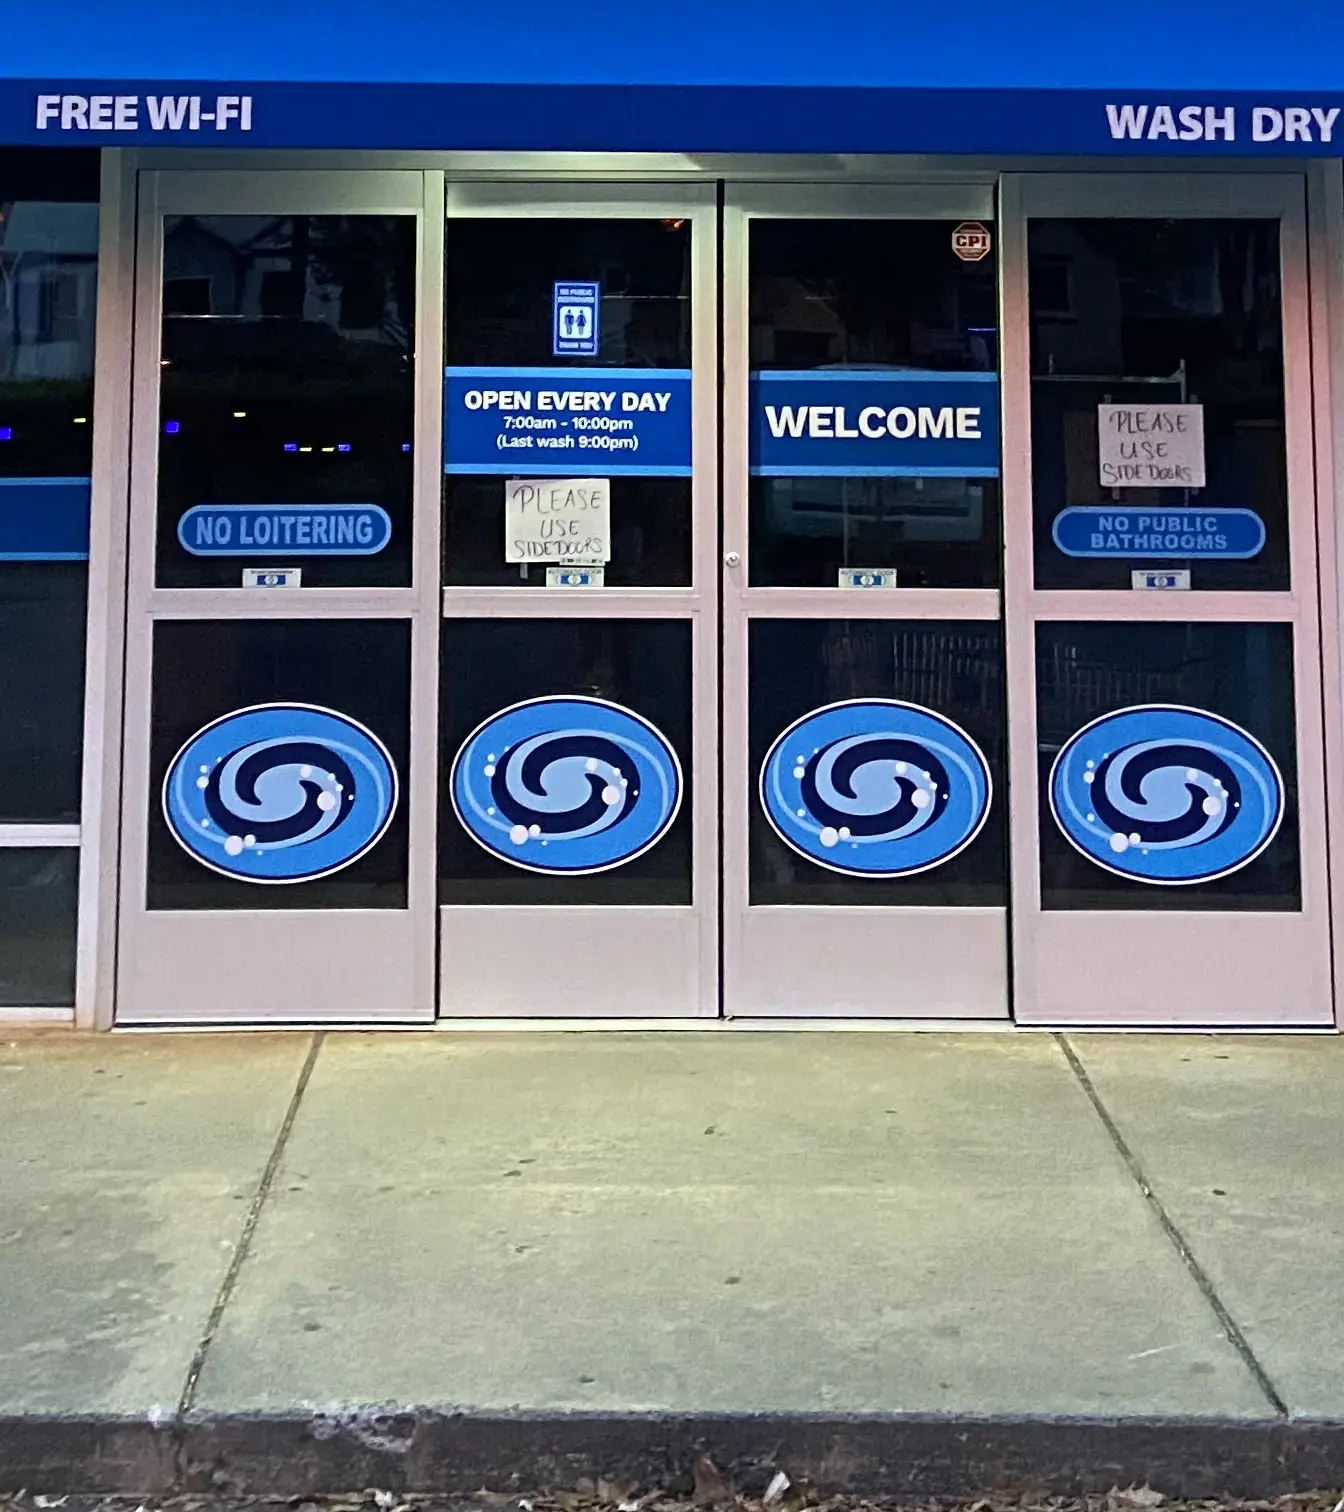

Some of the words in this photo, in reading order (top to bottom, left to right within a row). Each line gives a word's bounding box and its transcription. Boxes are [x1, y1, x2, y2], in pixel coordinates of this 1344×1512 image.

[36, 95, 139, 130] FREE
[146, 96, 252, 130] WI-FI
[1105, 104, 1235, 141] WASH
[1252, 107, 1341, 142] DRY
[956, 235, 987, 247] CPI
[464, 390, 532, 410] OPEN
[537, 391, 617, 411] EVERY
[621, 392, 672, 412] DAY
[503, 416, 557, 430] 7:00am
[571, 417, 634, 432] 10:00pm
[764, 406, 982, 438] WELCOME
[1109, 410, 1188, 434] PLEASE
[496, 434, 533, 450] (Last
[536, 435, 575, 448] wash
[578, 435, 639, 451] 9:00pm)
[1120, 441, 1168, 459] USE
[1102, 463, 1143, 484] SIDE
[512, 484, 602, 514] PLEASE
[196, 516, 232, 545] NO
[239, 515, 373, 545] LOITERING
[540, 518, 580, 539] USE
[1098, 516, 1129, 532] NO
[1138, 516, 1217, 532] PUBLIC
[1090, 533, 1228, 550] BATHROOMS
